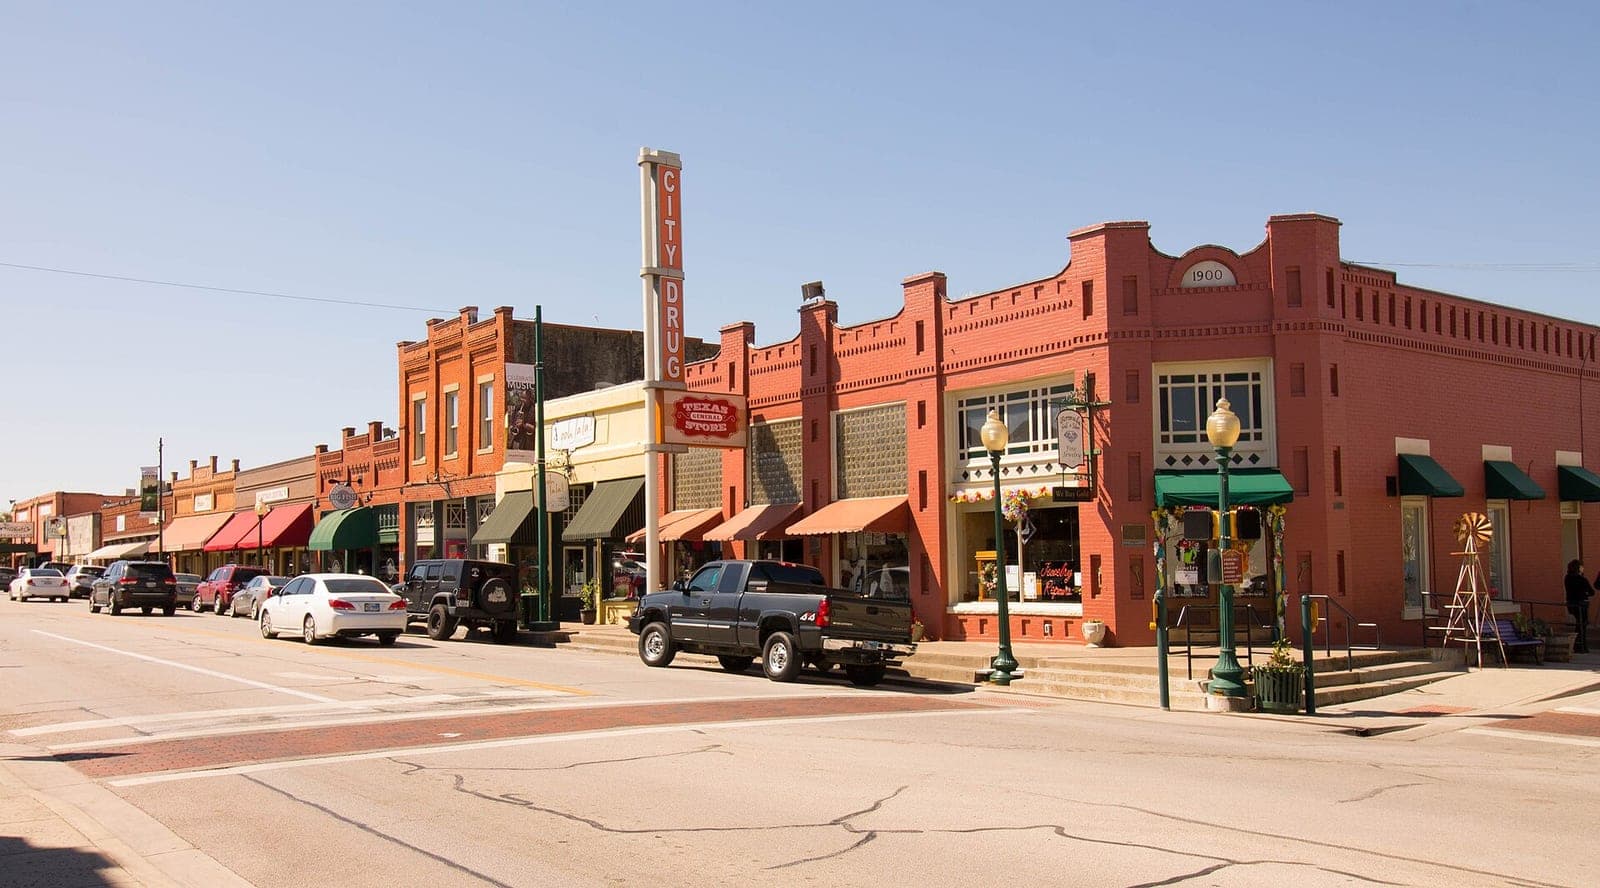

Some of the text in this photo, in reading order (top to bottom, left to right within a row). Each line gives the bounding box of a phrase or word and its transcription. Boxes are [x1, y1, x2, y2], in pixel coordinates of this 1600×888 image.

[663, 170, 680, 378] CITY DRUG
[1192, 269, 1223, 281] 1900
[507, 381, 535, 390] MUSIC
[683, 402, 728, 414] TEXAS
[692, 412, 720, 420] GENERAL
[685, 420, 727, 432] STORE
[1041, 562, 1073, 583] Jewelry
